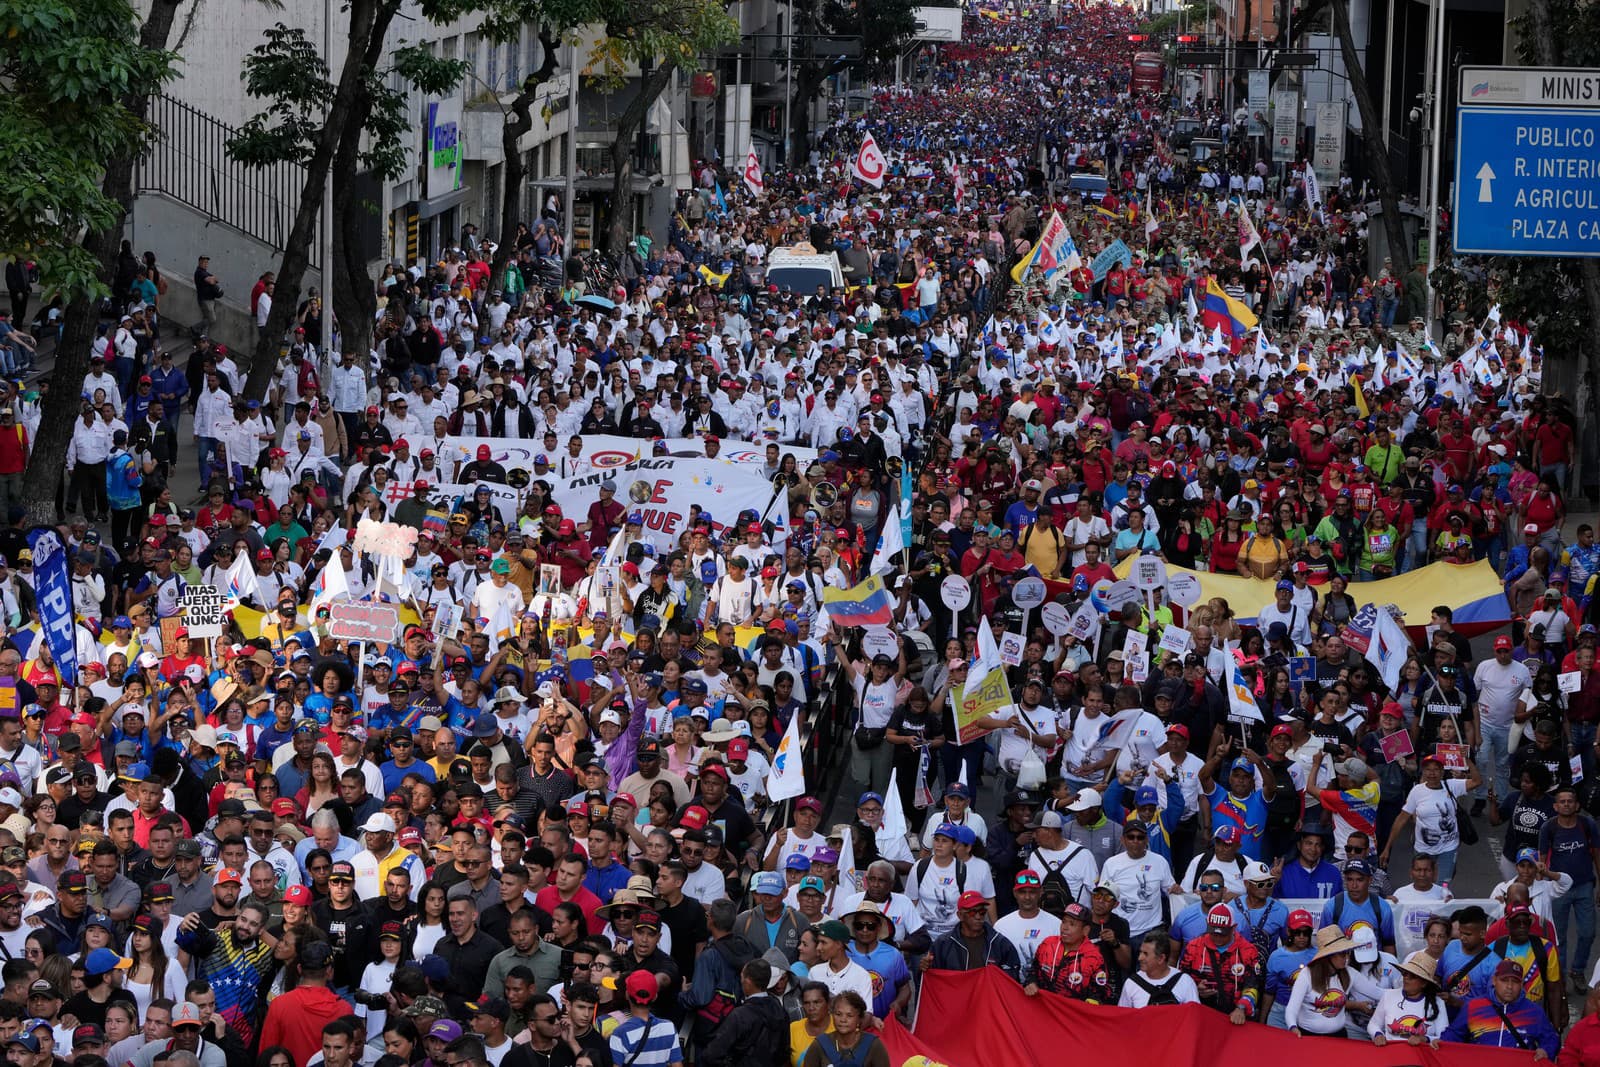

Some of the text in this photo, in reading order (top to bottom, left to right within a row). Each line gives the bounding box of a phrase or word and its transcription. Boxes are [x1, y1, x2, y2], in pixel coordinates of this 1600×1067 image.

[1515, 126, 1595, 148] PUBLICO
[1514, 157, 1531, 177] R.
[1514, 188, 1599, 209] AGRICUL
[1511, 218, 1569, 239] PLAZA
[649, 479, 674, 504] E
[186, 585, 218, 596] MAS
[175, 594, 229, 608] FUERTE
[190, 605, 220, 616] QUE
[180, 615, 229, 627] NUNCA
[1513, 823, 1543, 835] UNIVERSIT
